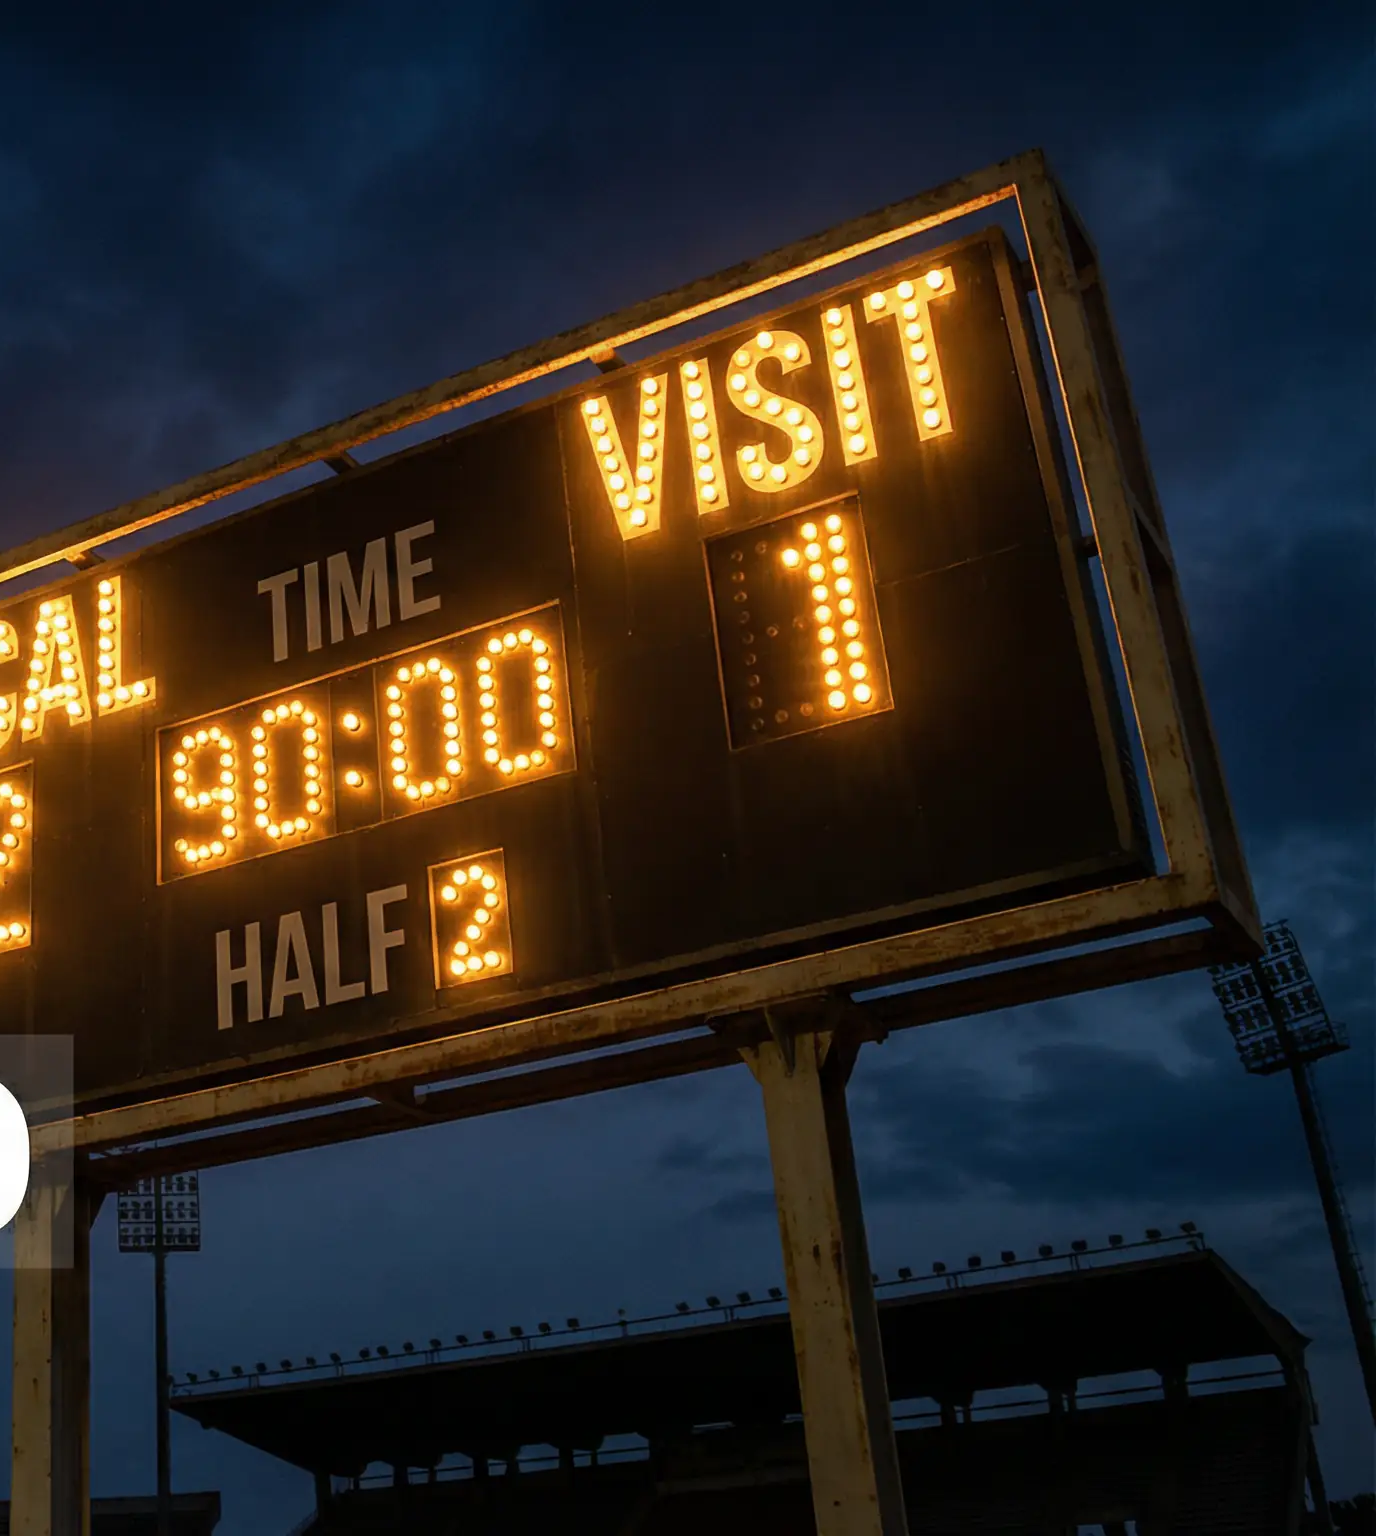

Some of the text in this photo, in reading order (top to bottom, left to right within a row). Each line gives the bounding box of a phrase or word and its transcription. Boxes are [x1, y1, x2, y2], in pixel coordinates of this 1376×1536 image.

[581, 267, 956, 541] VISIT
[258, 521, 441, 662] TIME
[780, 514, 874, 711] 1
[172, 627, 560, 864] 90:00
[215, 864, 503, 1030] HALF 2
